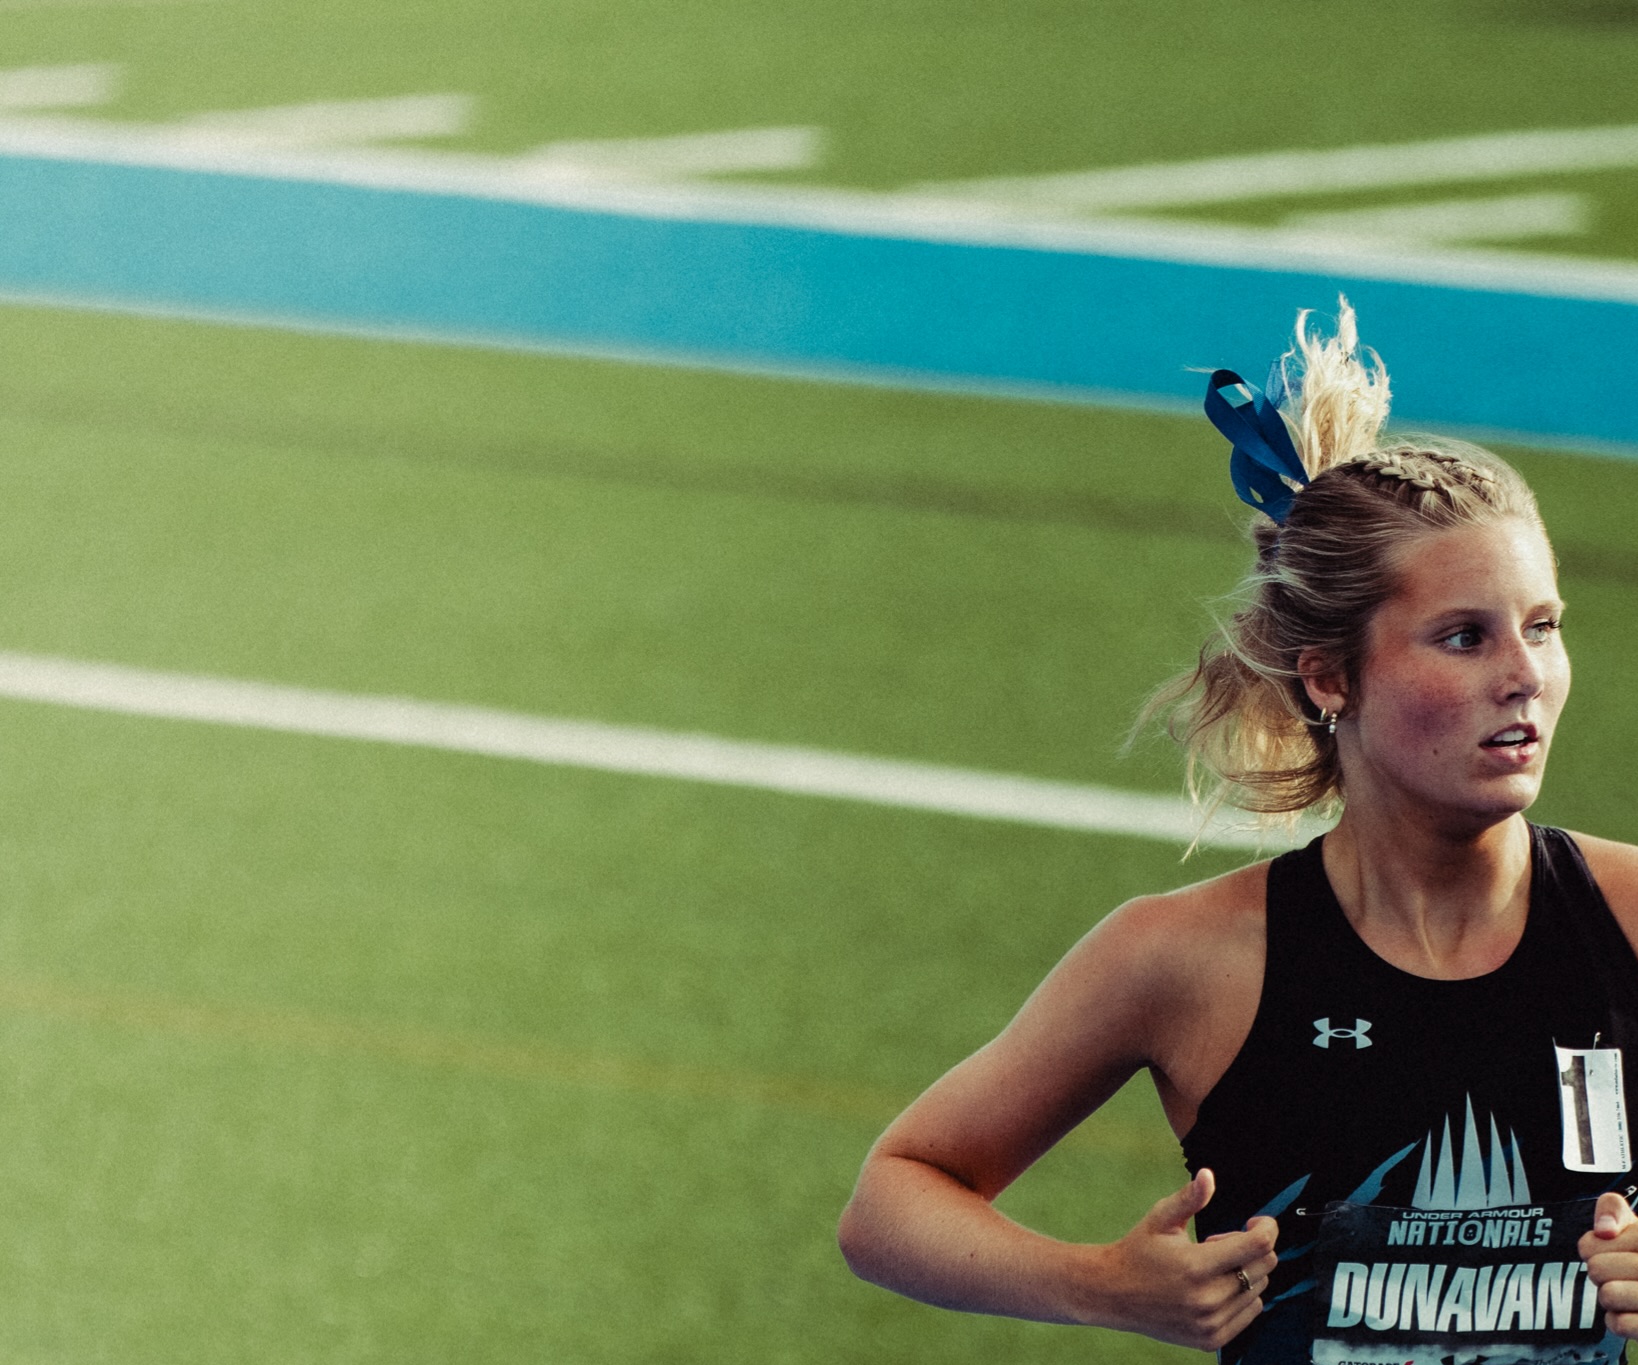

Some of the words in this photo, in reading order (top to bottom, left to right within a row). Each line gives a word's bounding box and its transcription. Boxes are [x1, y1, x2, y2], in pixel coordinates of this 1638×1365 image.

[1561, 1055, 1595, 1165] 1
[1387, 1218, 1553, 1249] NATIONALS
[1402, 1211, 1466, 1221] UNDER
[1467, 1207, 1544, 1220] ARMOUR
[1327, 1261, 1599, 1333] DUNAVANT
